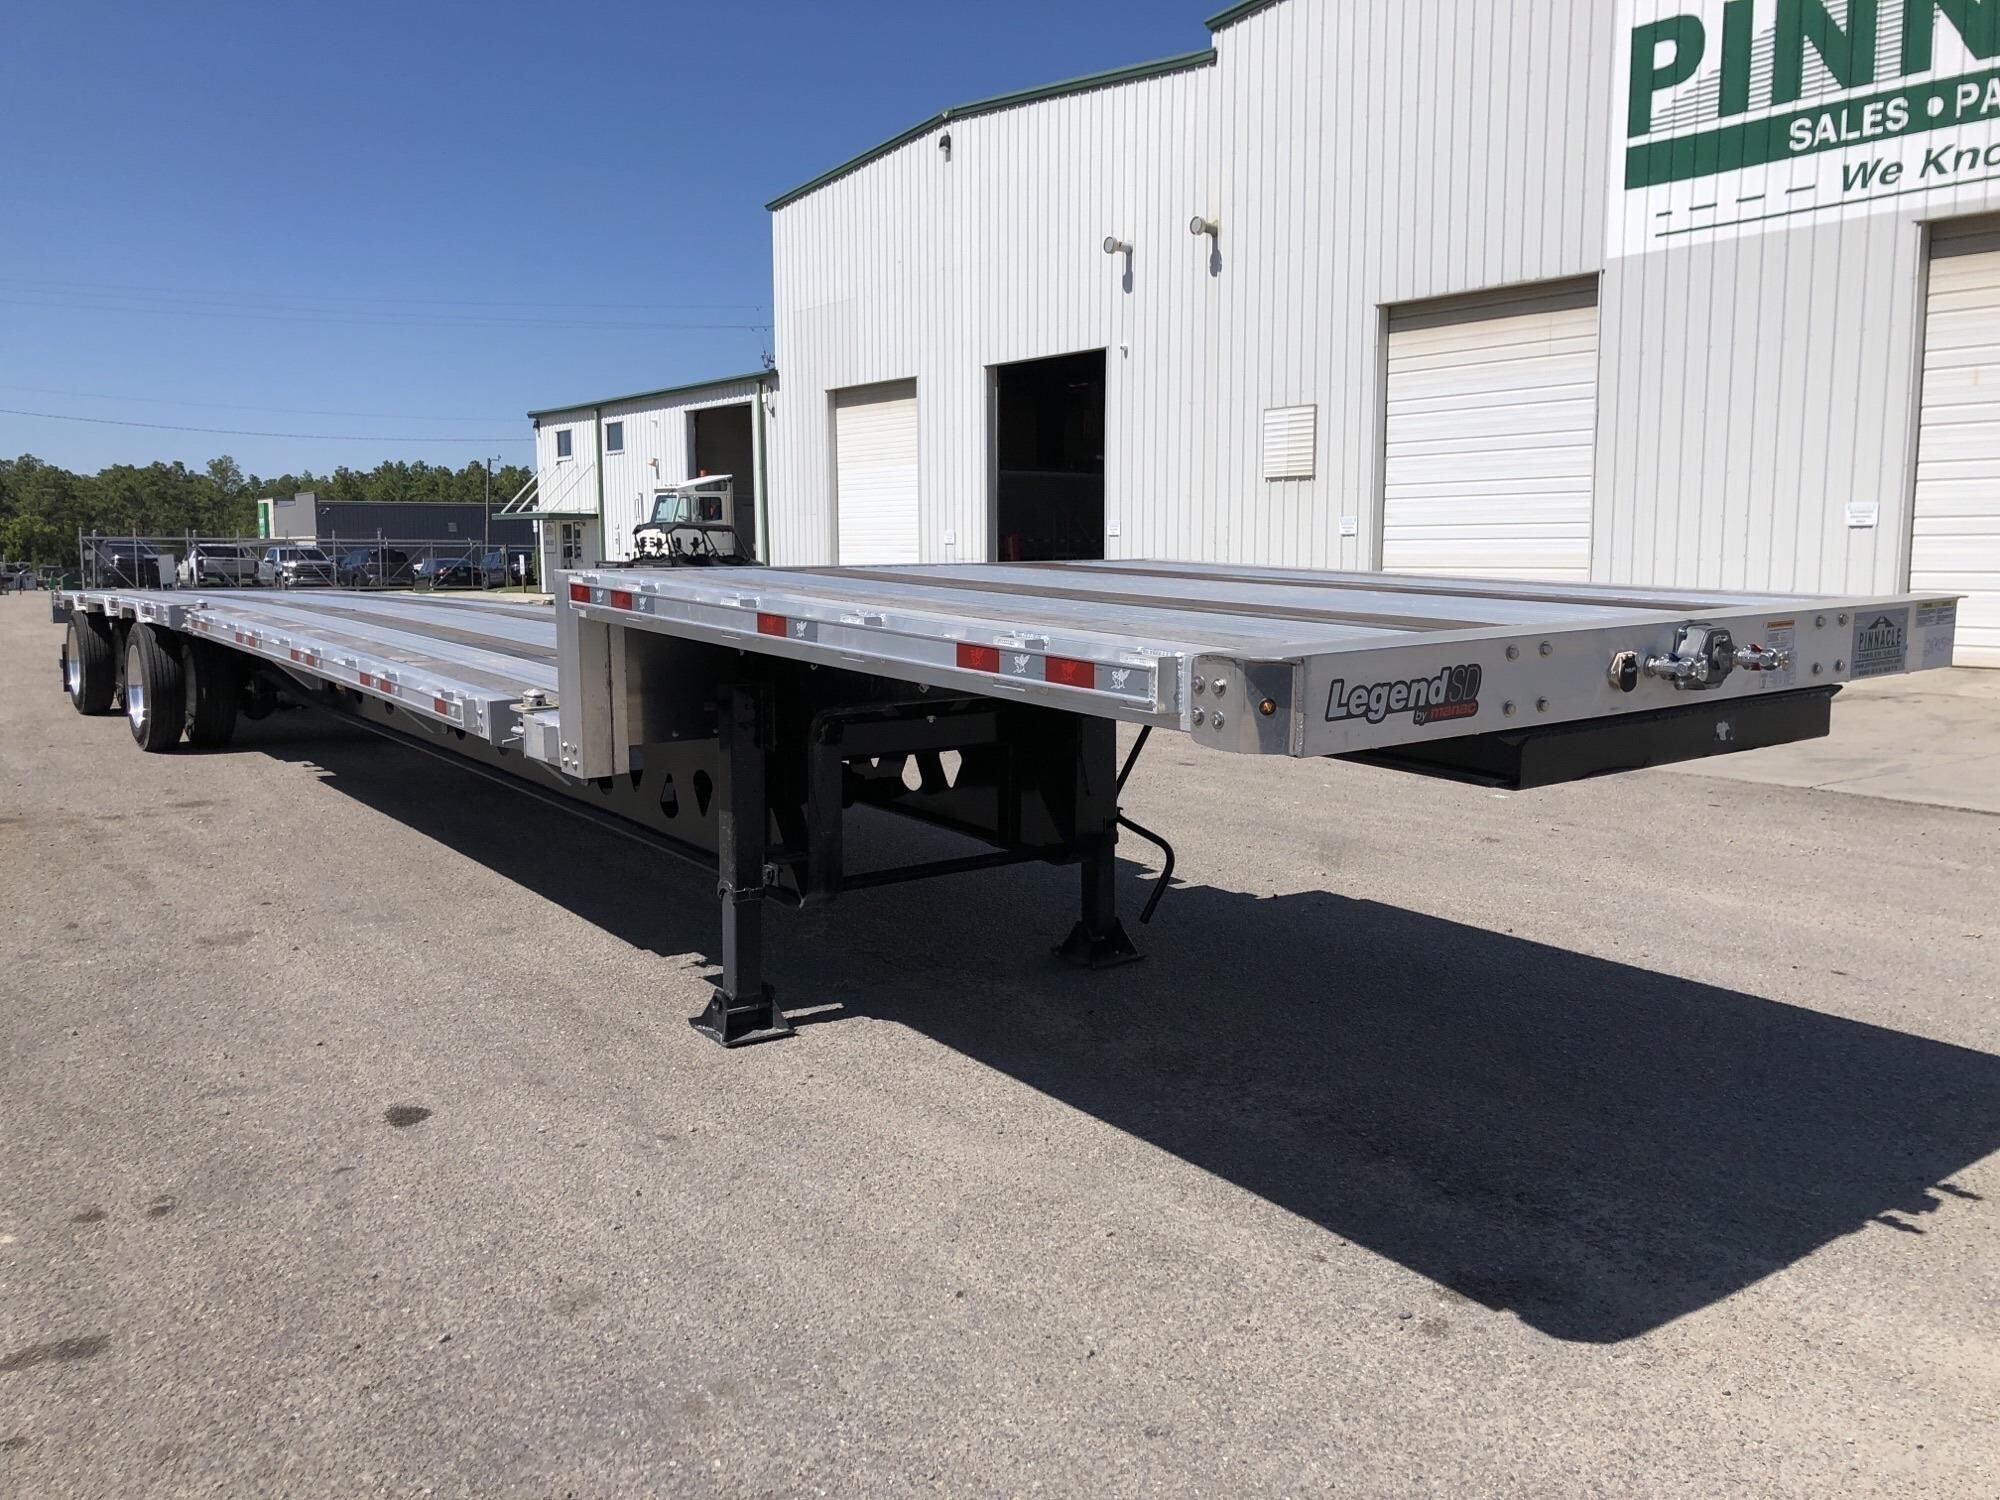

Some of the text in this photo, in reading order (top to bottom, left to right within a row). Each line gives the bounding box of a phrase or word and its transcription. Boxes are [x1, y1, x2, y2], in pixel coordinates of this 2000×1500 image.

[1789, 97, 1909, 151] SALES
[1842, 156, 1904, 191] We
[1858, 628, 1902, 649] PINNACLE
[1415, 709, 1427, 724] by
